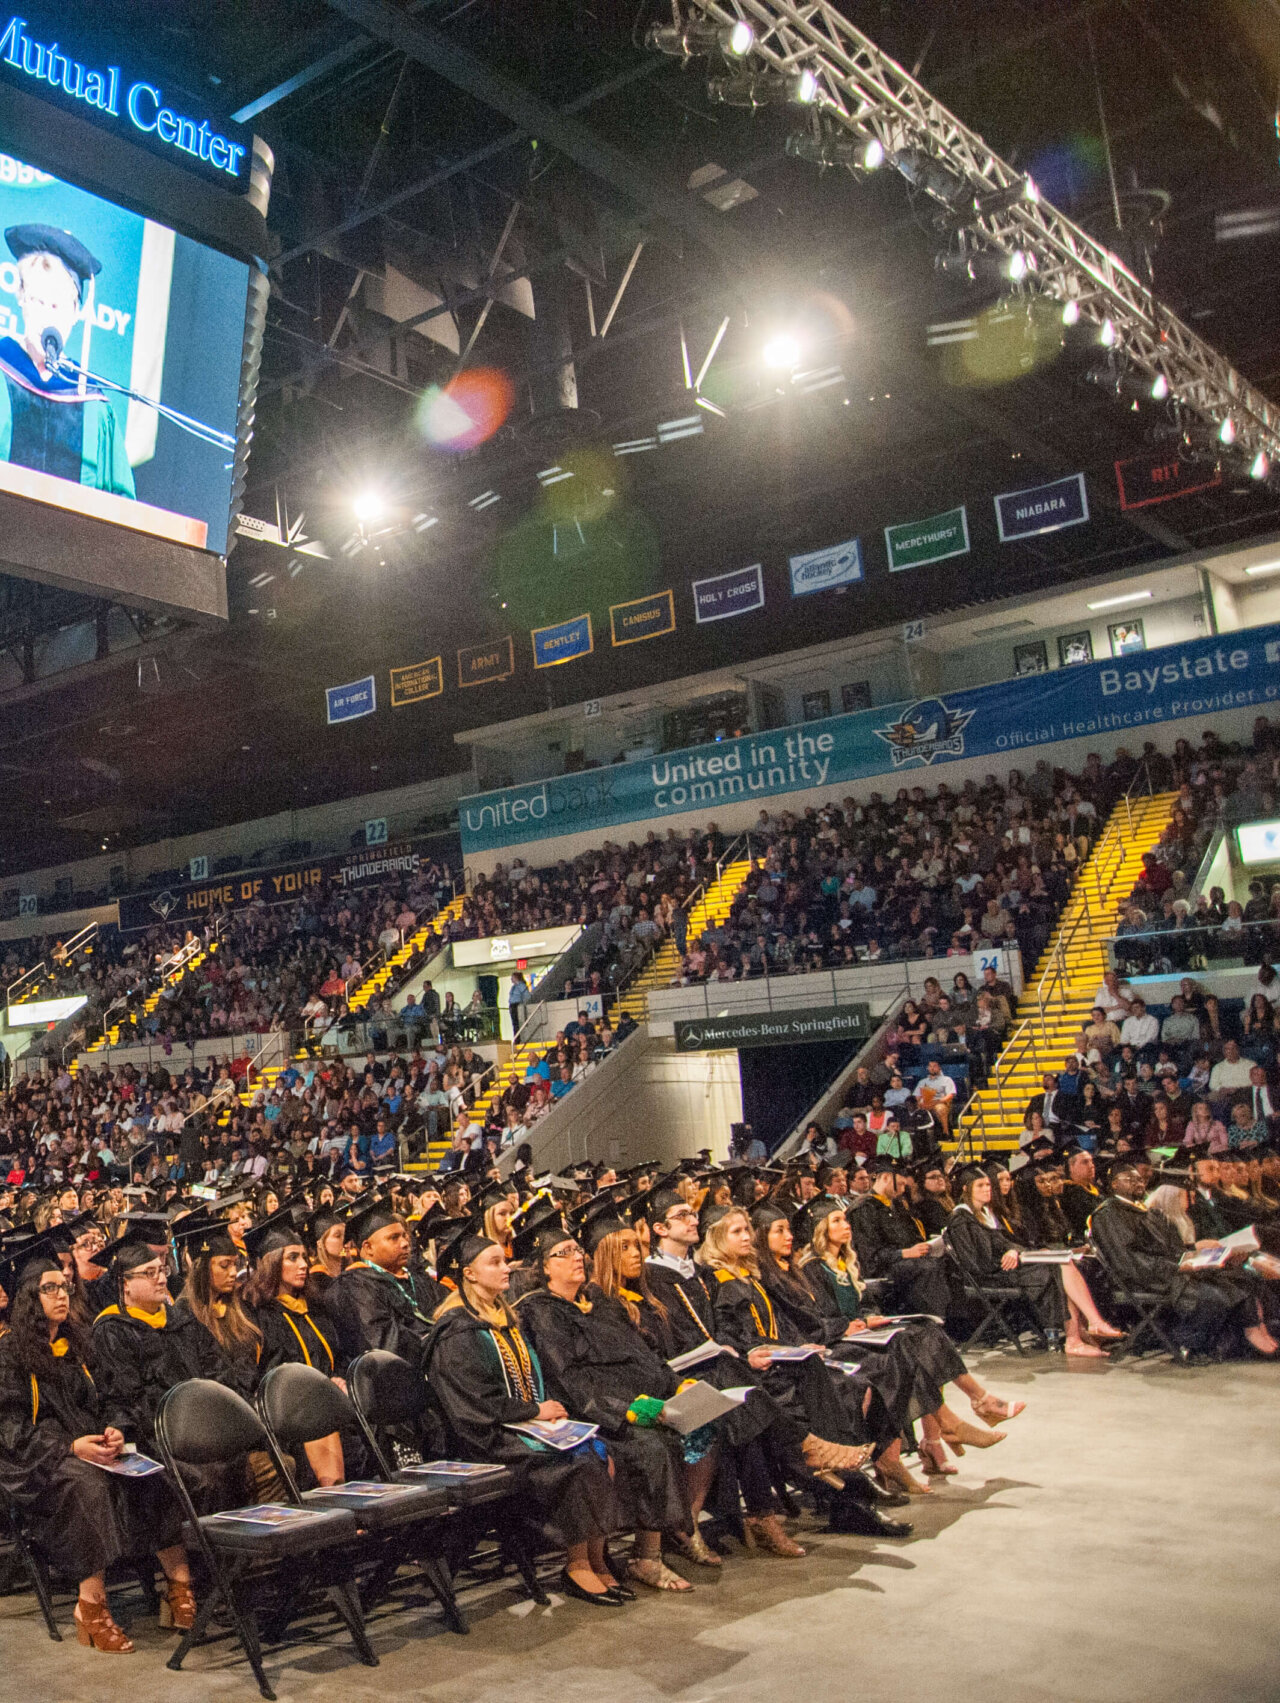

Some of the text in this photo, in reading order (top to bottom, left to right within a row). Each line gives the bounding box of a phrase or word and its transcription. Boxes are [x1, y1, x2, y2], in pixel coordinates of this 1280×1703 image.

[128, 81, 245, 177] Center
[1152, 461, 1179, 483] RIT
[1016, 497, 1066, 520] NIAGARA
[895, 526, 958, 551] MERCYHURST
[700, 581, 757, 605] HOLY CROSS
[623, 608, 661, 627] CANISIUS
[543, 631, 581, 650] BENTLEY
[906, 623, 923, 639] 24
[471, 653, 499, 671] ARMY
[1100, 649, 1249, 696] Baystate
[333, 690, 368, 709] AIR FORCE
[586, 701, 601, 716] 23
[996, 725, 1055, 749] Official
[1063, 705, 1163, 736] Healthcare
[1172, 688, 1254, 716] Provider
[651, 732, 834, 787] United in the
[654, 756, 830, 808] community
[369, 820, 385, 841] 22
[345, 845, 412, 864] SPRINGFIELD
[193, 859, 205, 877] 21
[339, 854, 420, 886] THUNDERBIRDS
[186, 868, 321, 910] HOME OF YOUR
[20, 898, 36, 913] 20
[585, 1001, 599, 1013] 24
[704, 1014, 860, 1041] Mercedes-Benz Springfield
